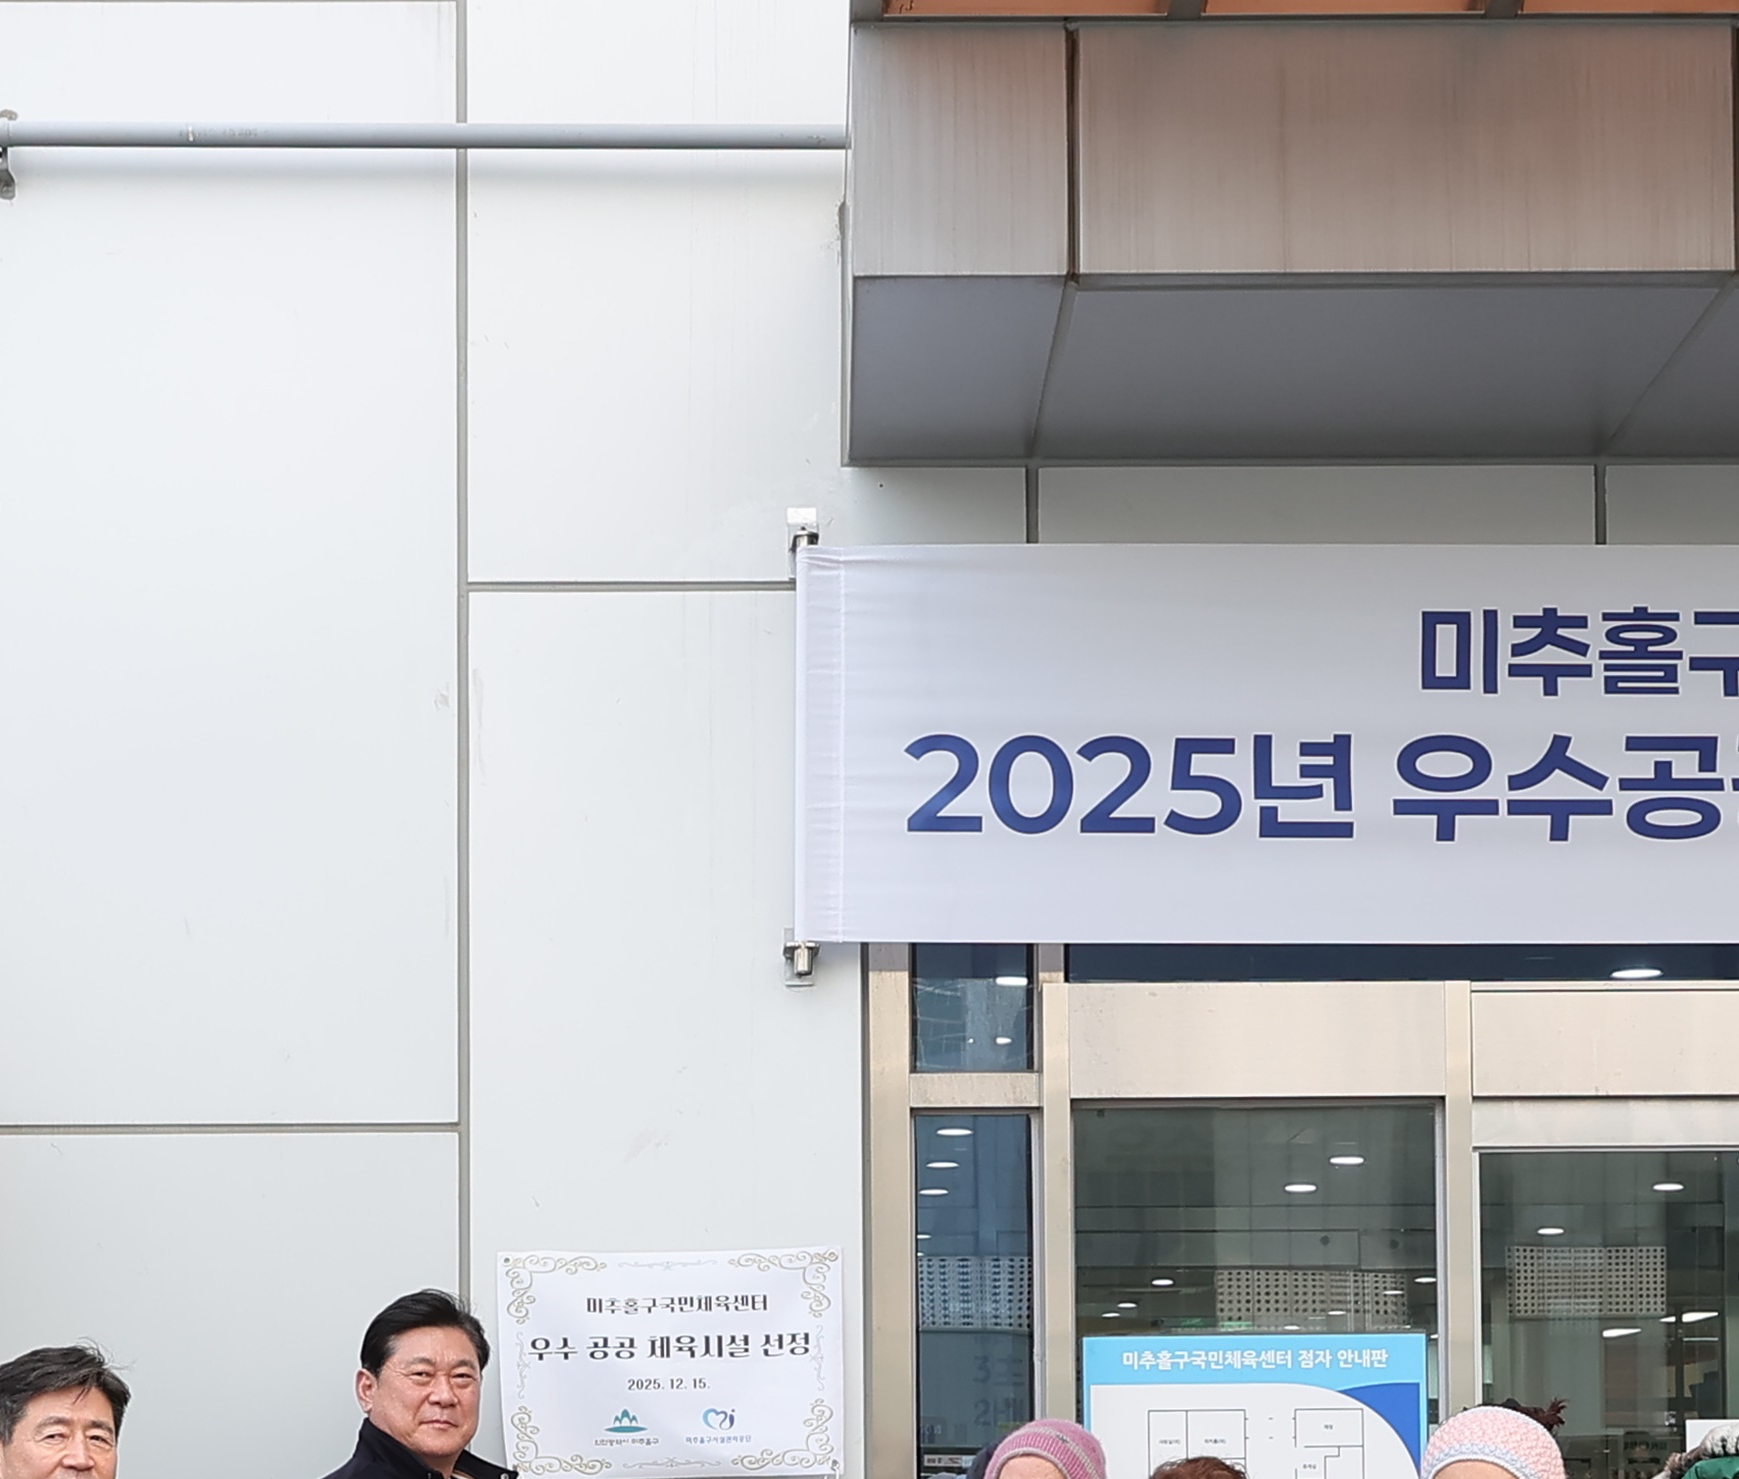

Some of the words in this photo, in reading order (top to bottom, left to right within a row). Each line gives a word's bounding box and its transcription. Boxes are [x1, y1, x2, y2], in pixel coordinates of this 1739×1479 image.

[903, 733, 1355, 840] 2025년
[585, 1294, 769, 1315] 미추홀구국민체육센터
[527, 1336, 579, 1361] 우수
[586, 1335, 638, 1360] 공공
[647, 1333, 751, 1359] 체육시설
[760, 1331, 811, 1358] 선정
[1121, 1349, 1292, 1370] 미추홀구국민체육센터
[1297, 1349, 1333, 1369] 점자
[1337, 1348, 1389, 1369] 안내판
[627, 1378, 665, 1391] 2025.
[669, 1378, 688, 1390] 12.
[691, 1377, 711, 1390] 15.
